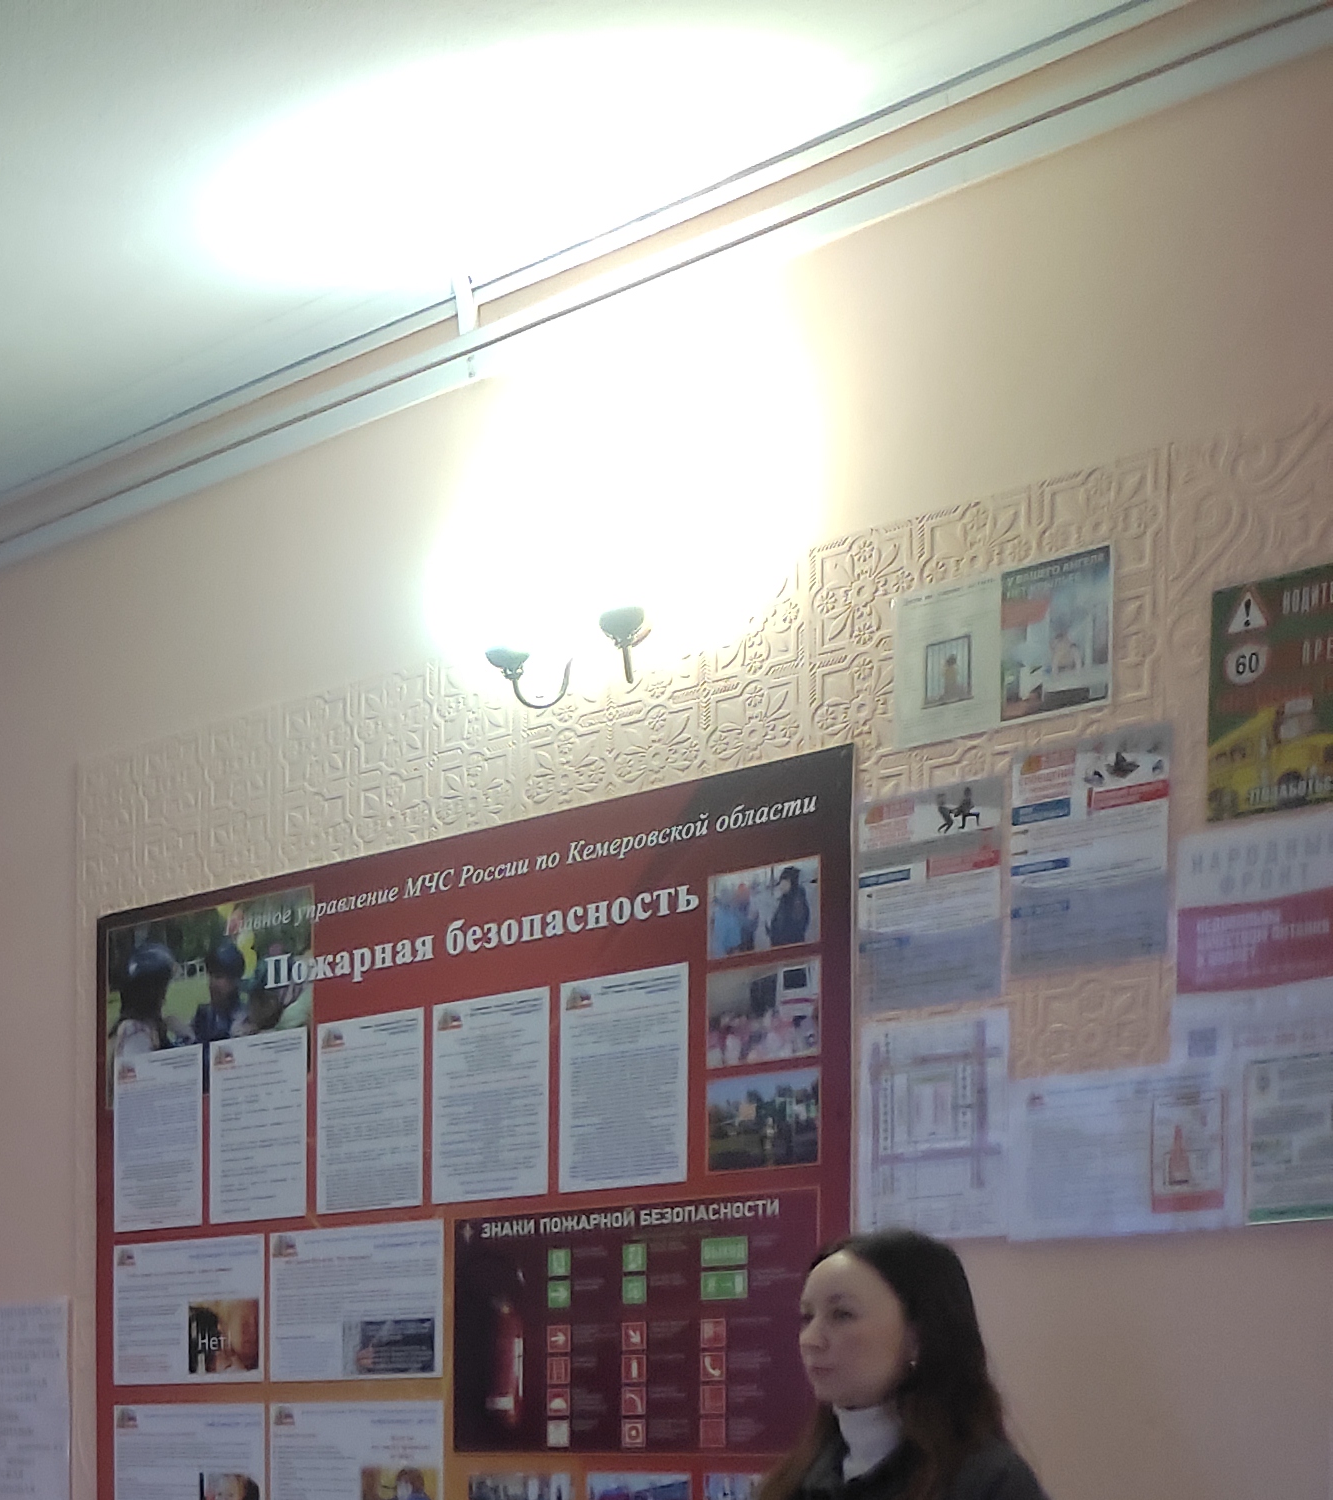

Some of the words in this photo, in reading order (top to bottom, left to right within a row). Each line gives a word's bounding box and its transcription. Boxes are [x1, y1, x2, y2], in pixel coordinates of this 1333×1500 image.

[1235, 652, 1260, 676] 60
[294, 886, 399, 926] управление
[403, 869, 456, 899] МЧС
[458, 855, 530, 888] России
[535, 850, 561, 871] по
[566, 813, 710, 865] Кемеровской
[715, 794, 818, 833] области
[264, 934, 435, 990] Пожарная
[445, 884, 701, 957] безопасность
[480, 1219, 535, 1239] ЗНАКИ
[539, 1207, 635, 1234] ПОЖАРНОЙ
[640, 1198, 780, 1227] БЕЗОПАСНОСТИ
